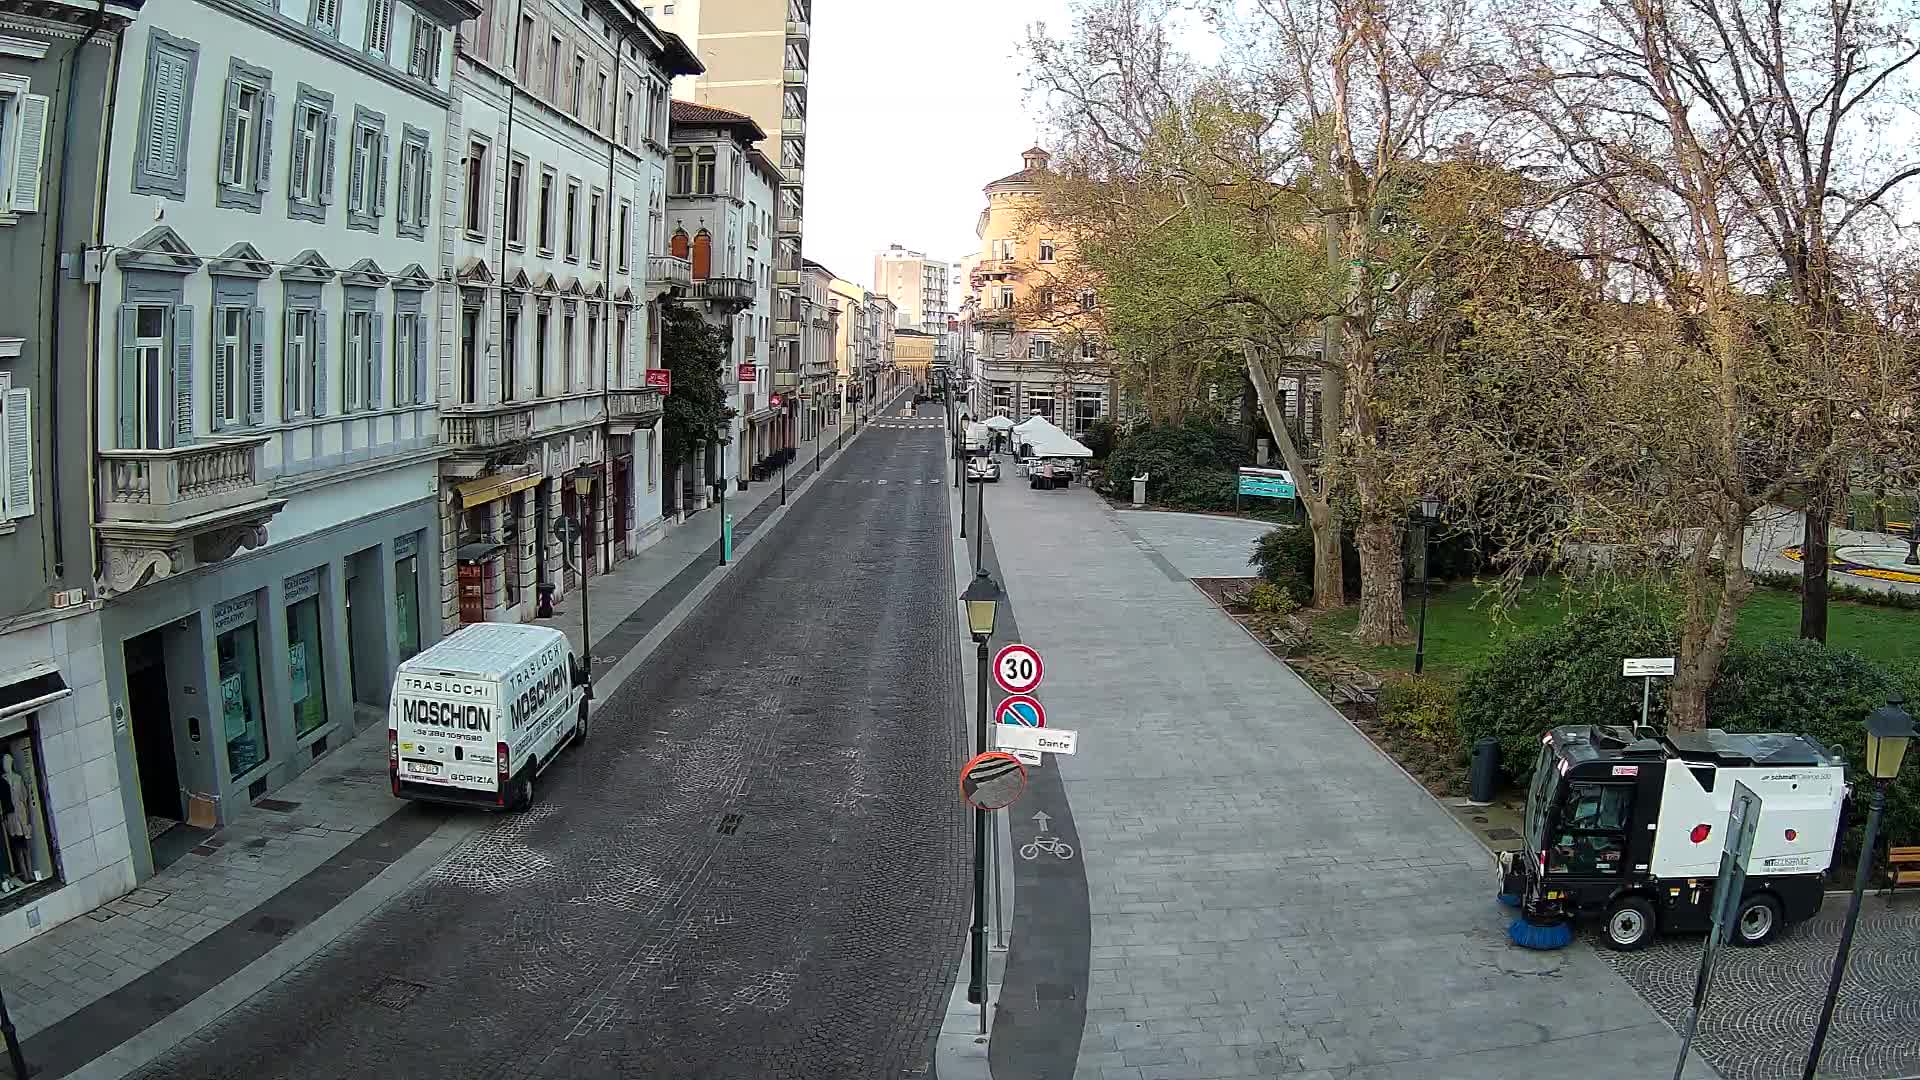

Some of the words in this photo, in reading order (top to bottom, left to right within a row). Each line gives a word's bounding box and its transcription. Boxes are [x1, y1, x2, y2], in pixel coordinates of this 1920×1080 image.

[510, 644, 563, 692] TRASLOCHI
[1005, 658, 1033, 680] 30
[404, 679, 488, 697] TRASLOCHI
[510, 660, 568, 732] MOSCHION
[403, 698, 491, 732] MOSCHION
[1038, 738, 1070, 749] Dante
[450, 773, 495, 785] GORIZIA
